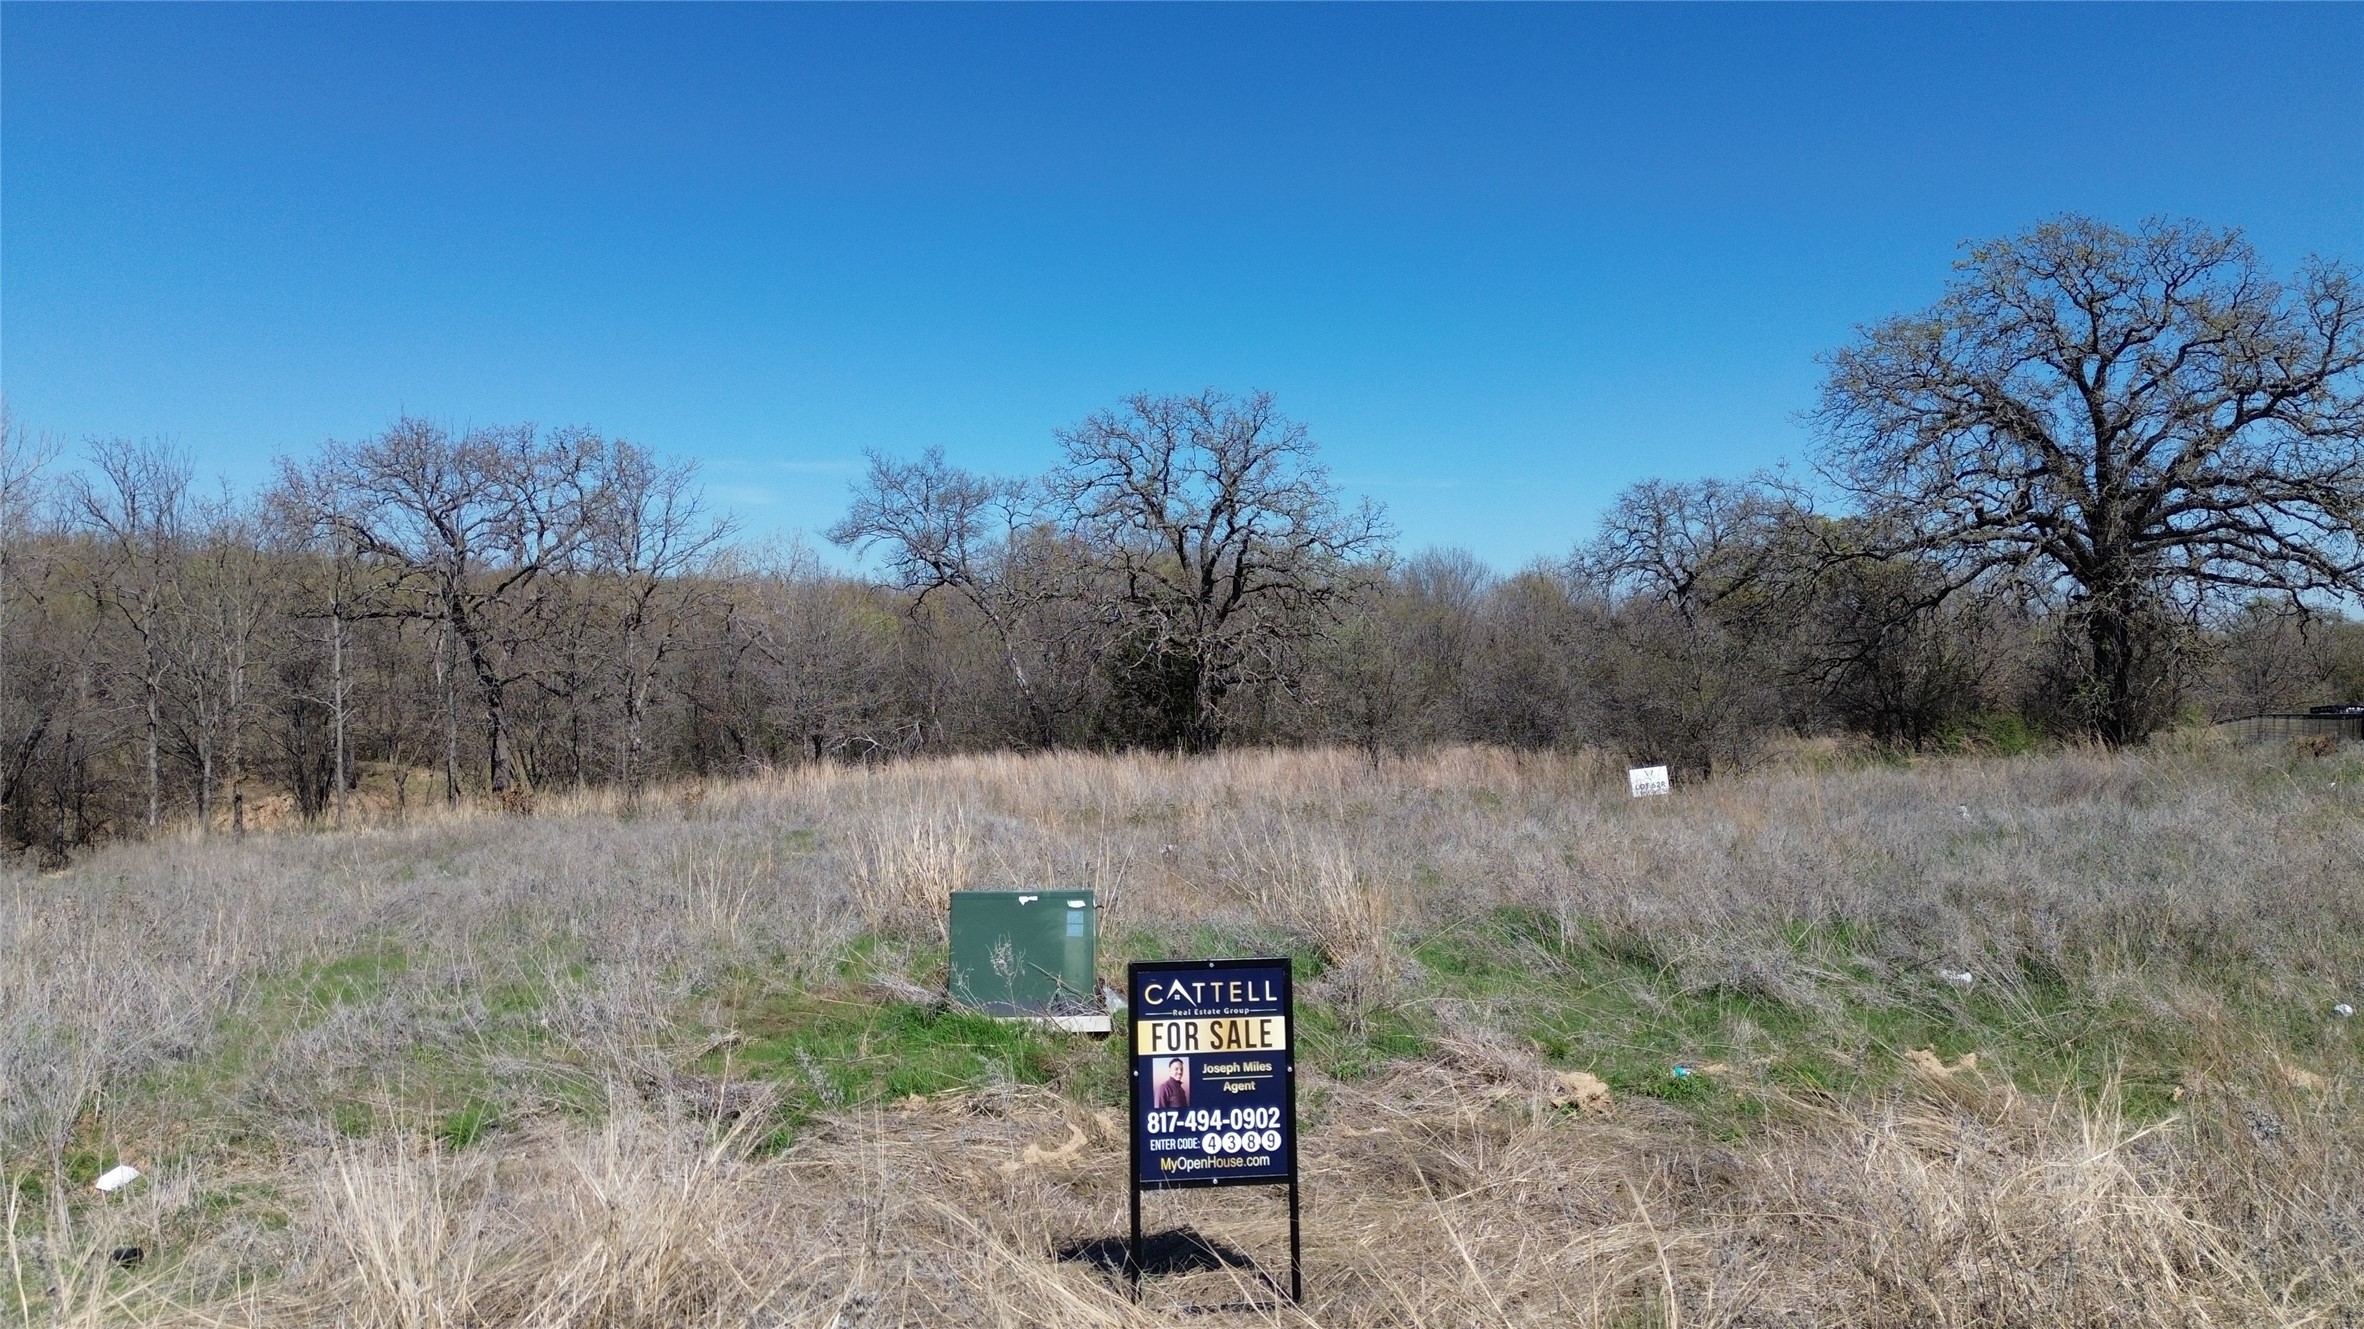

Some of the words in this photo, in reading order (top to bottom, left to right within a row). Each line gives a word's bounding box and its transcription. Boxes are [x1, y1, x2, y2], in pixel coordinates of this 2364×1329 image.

[1635, 782, 1649, 790] LOT
[1145, 979, 1278, 1007] CATTELL
[1223, 1007, 1250, 1015] Group
[1152, 1021, 1199, 1052] FOR
[1210, 1019, 1273, 1050] SALE
[1202, 1062, 1240, 1074] Joseph
[1243, 1061, 1272, 1072] Miles
[1223, 1081, 1256, 1094] Agent
[1147, 1107, 1281, 1133] 817-494-0902
[1150, 1138, 1176, 1151] ENTER
[1177, 1137, 1201, 1150] CODE:
[1160, 1154, 1270, 1173] MyOpenHouse.com
